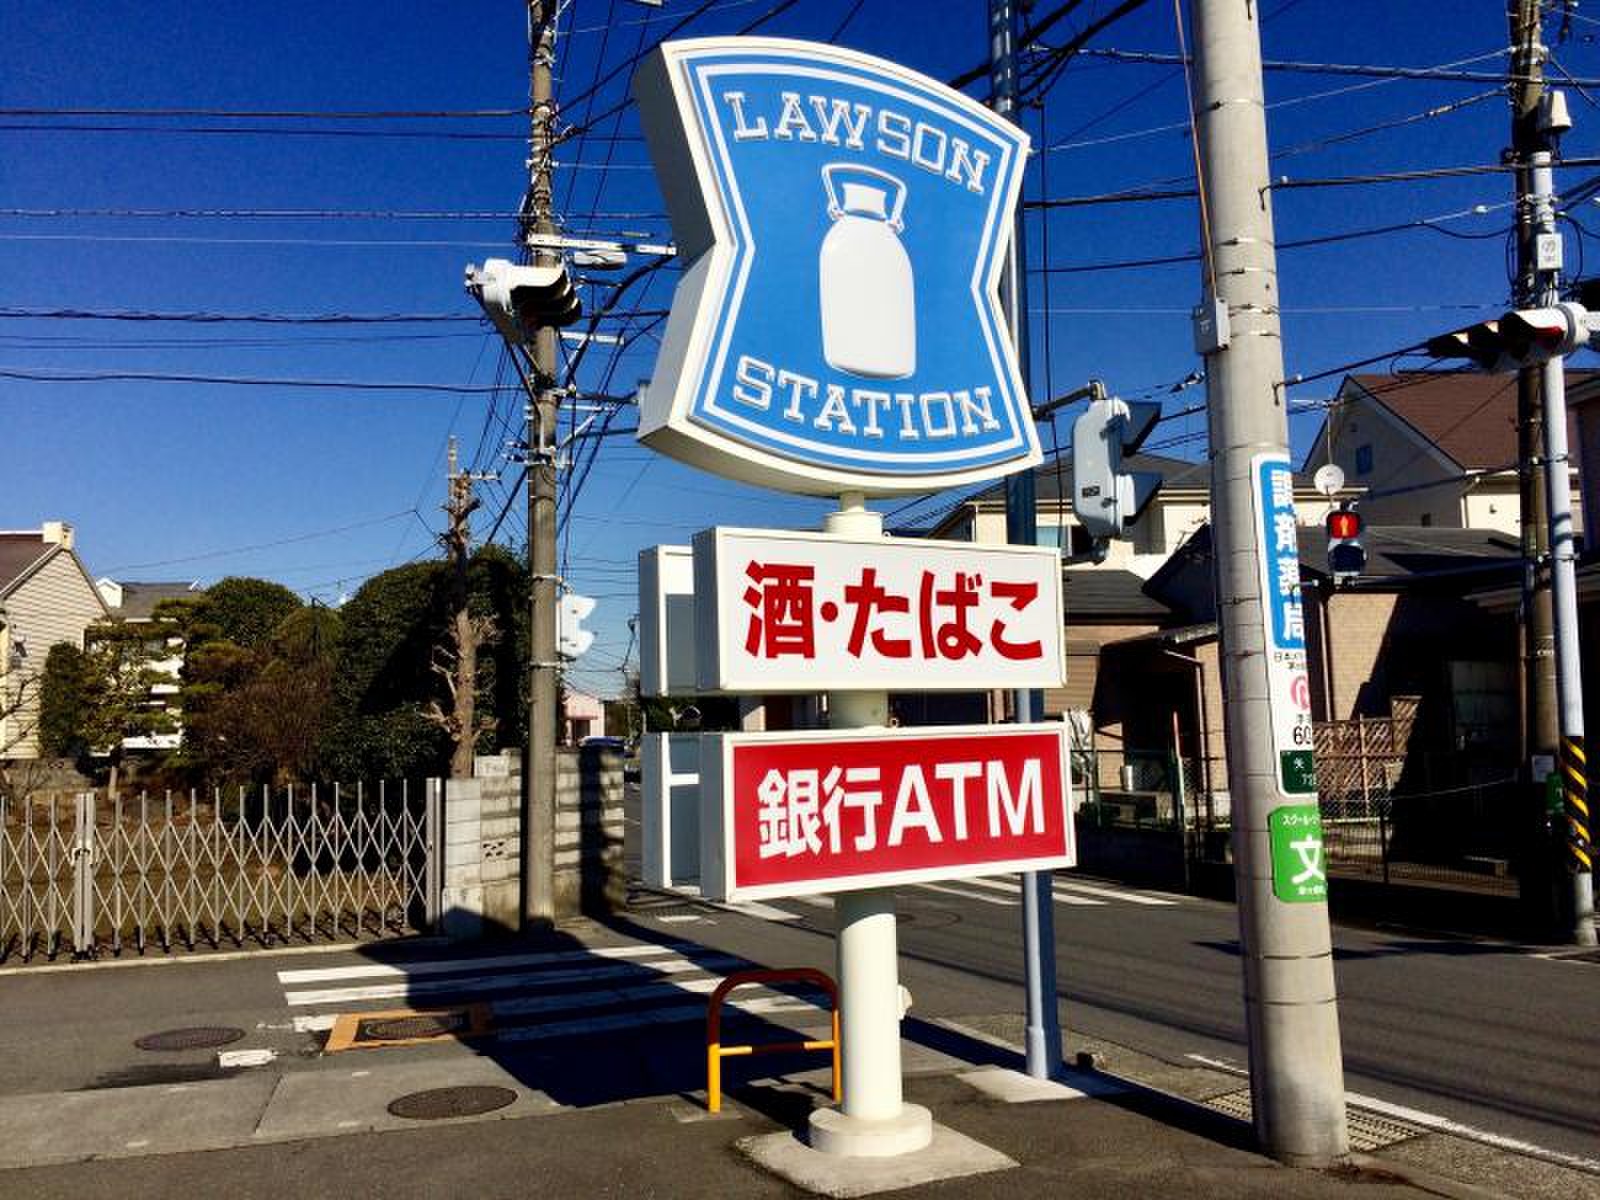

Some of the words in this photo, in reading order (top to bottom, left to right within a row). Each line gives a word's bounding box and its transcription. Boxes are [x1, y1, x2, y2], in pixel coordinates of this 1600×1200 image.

[723, 91, 991, 194] LAWSON
[732, 355, 1001, 439] STATION
[744, 560, 1044, 661] 酒・たばこ
[757, 758, 1046, 859] 銀行ATM
